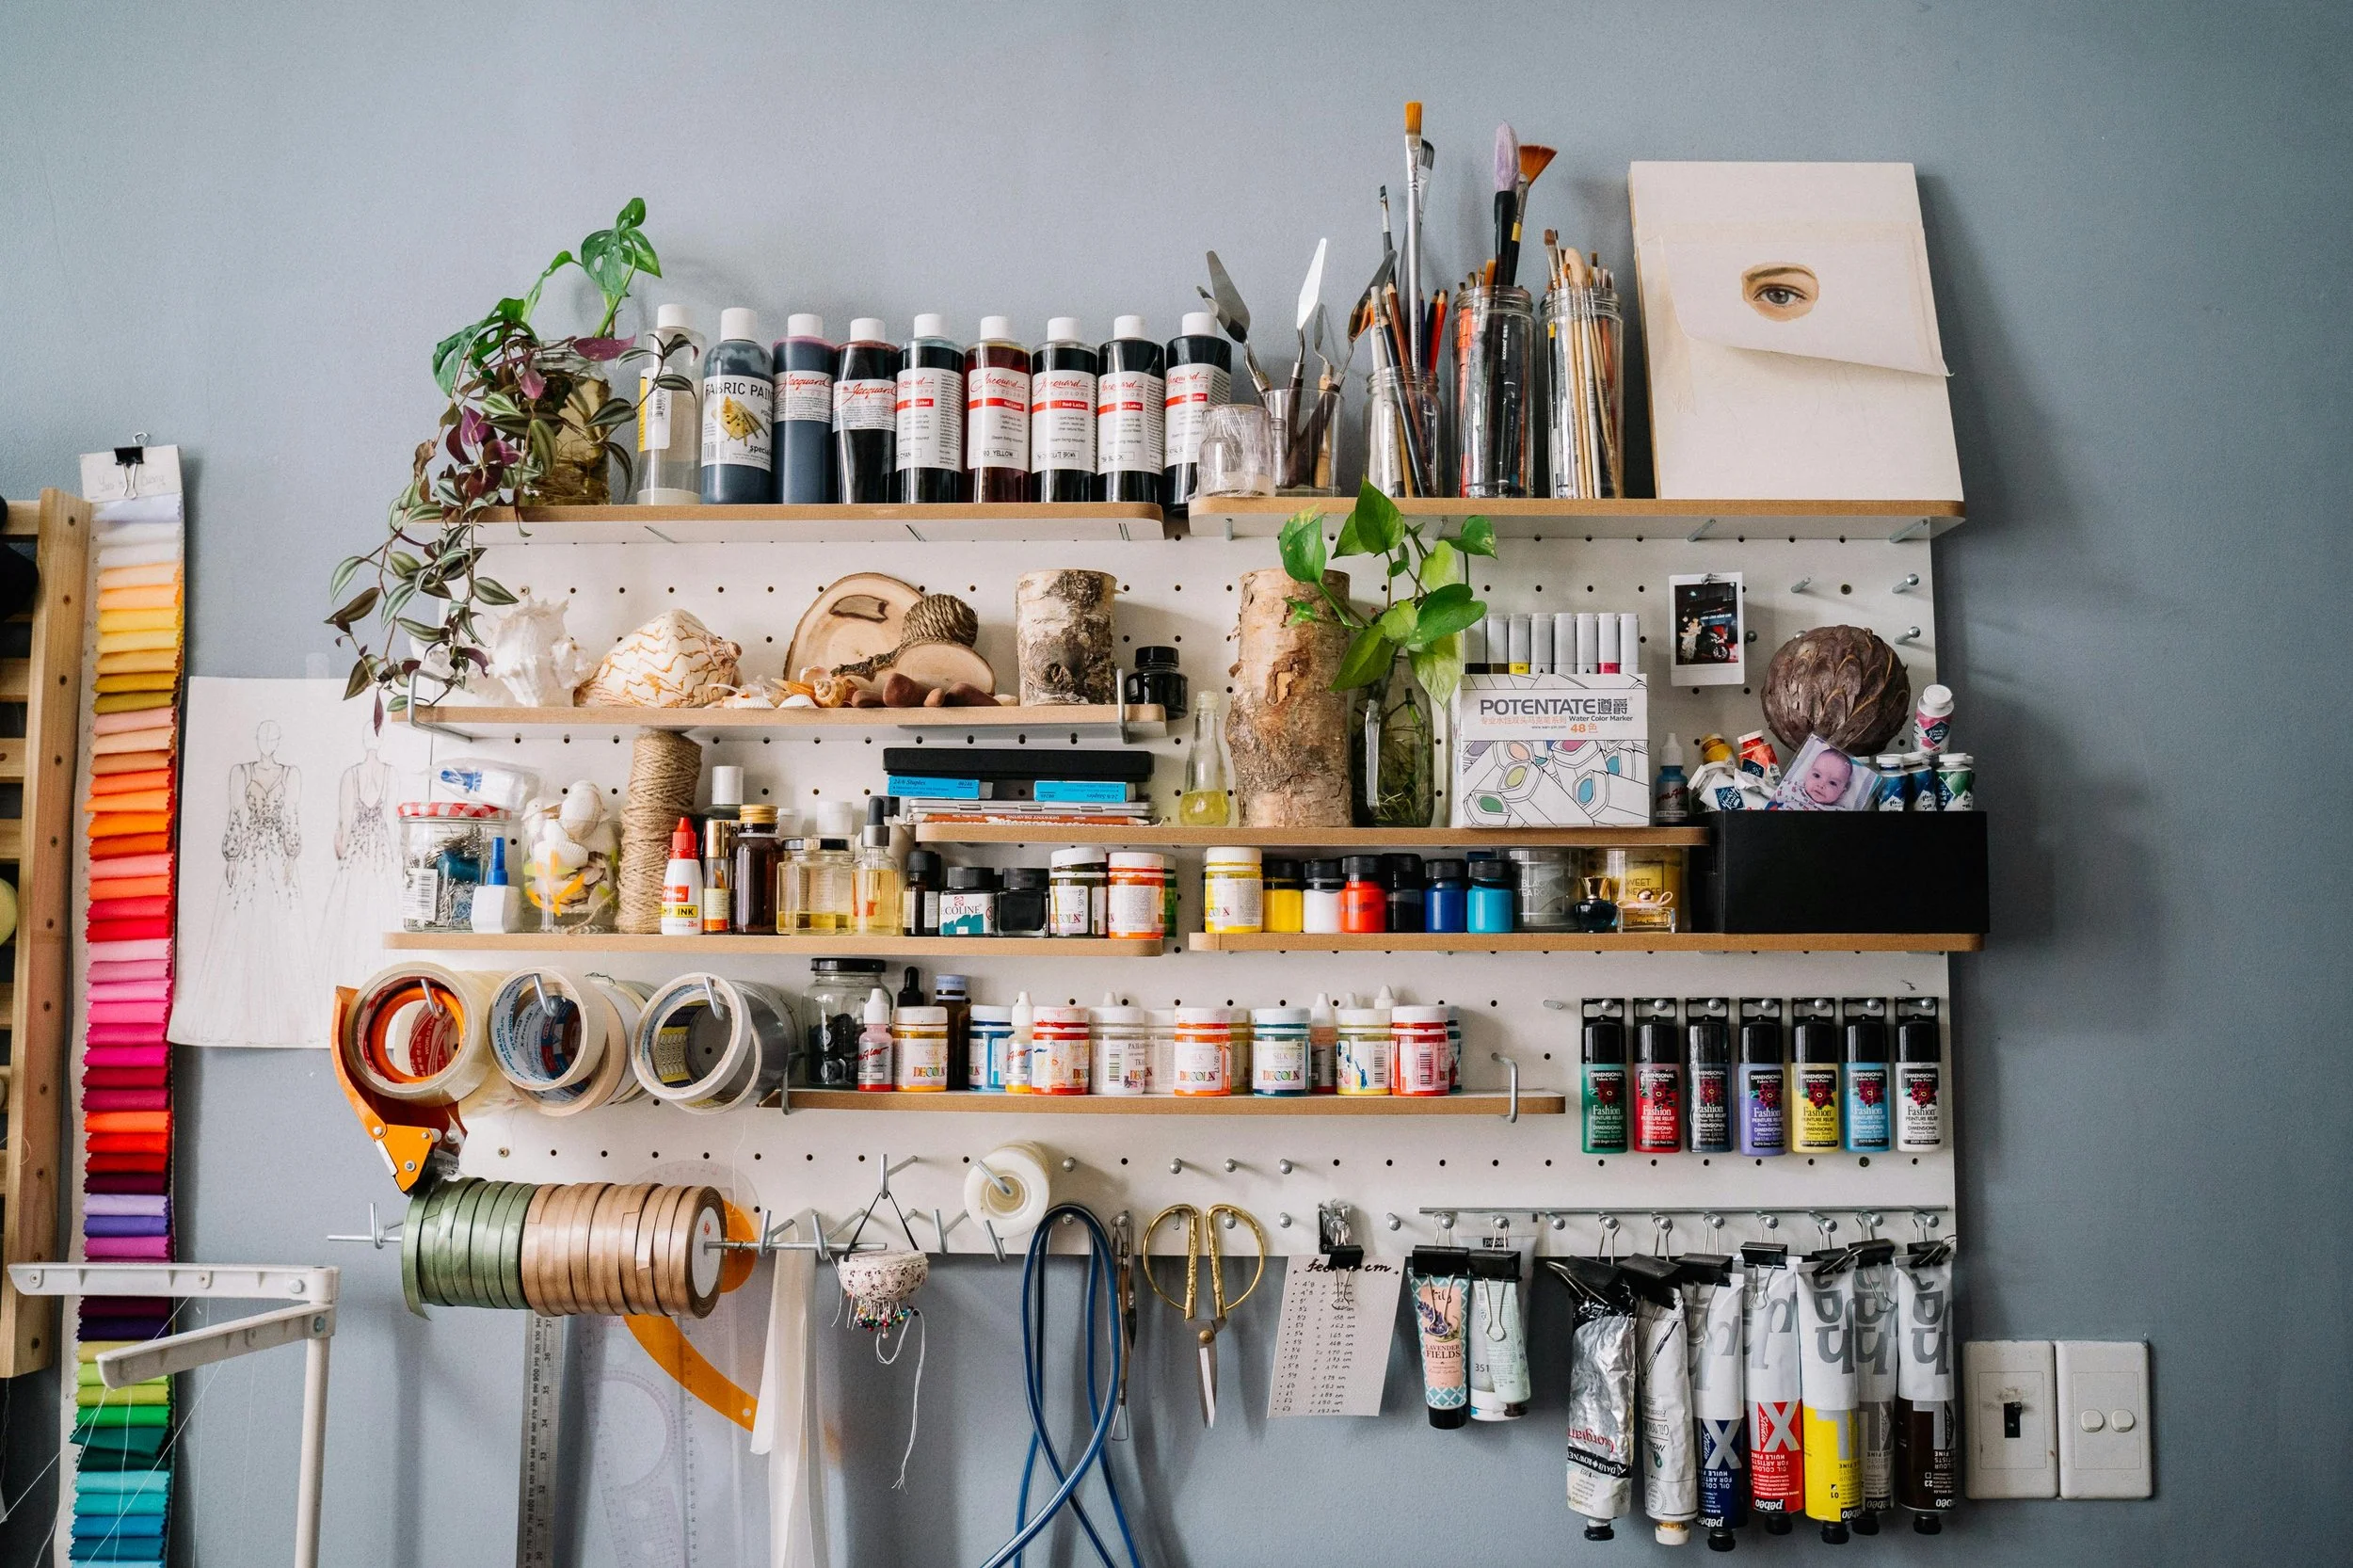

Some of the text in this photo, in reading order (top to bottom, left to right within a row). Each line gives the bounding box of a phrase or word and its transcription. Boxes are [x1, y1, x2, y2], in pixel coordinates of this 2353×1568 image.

[705, 382, 746, 396] FABRIC
[1480, 698, 1596, 715] POTENTATE
[1570, 724, 1586, 733] 48
[1625, 877, 1652, 886] WEET
[677, 907, 695, 916] INK
[509, 990, 522, 1011] BRAND
[496, 1028, 505, 1052] BRAND
[508, 1036, 517, 1050] NEW
[1179, 1070, 1216, 1081] DECOLA
[1262, 1070, 1300, 1081] DECOLA
[1593, 1104, 1621, 1115] Fashion
[1642, 1105, 1672, 1116] Fashion
[1753, 1107, 1781, 1118] Fashion
[1803, 1107, 1832, 1117] Fashion
[1853, 1104, 1882, 1116] Fashion
[1907, 1105, 1936, 1116] Fashion
[1365, 1263, 1391, 1272] cm
[546, 1320, 552, 1328] 37
[544, 1352, 551, 1361] 36
[1426, 1350, 1462, 1359] FIELDS
[1475, 1363, 1490, 1372] 351
[543, 1385, 550, 1395] 35
[542, 1419, 548, 1429] 34
[1758, 1412, 1769, 1443] Studio
[540, 1451, 546, 1461] 33
[1751, 1458, 1775, 1466] ARTISTS
[1752, 1464, 1775, 1473] COLOUR
[538, 1485, 546, 1495] 32
[536, 1551, 542, 1560] 30
